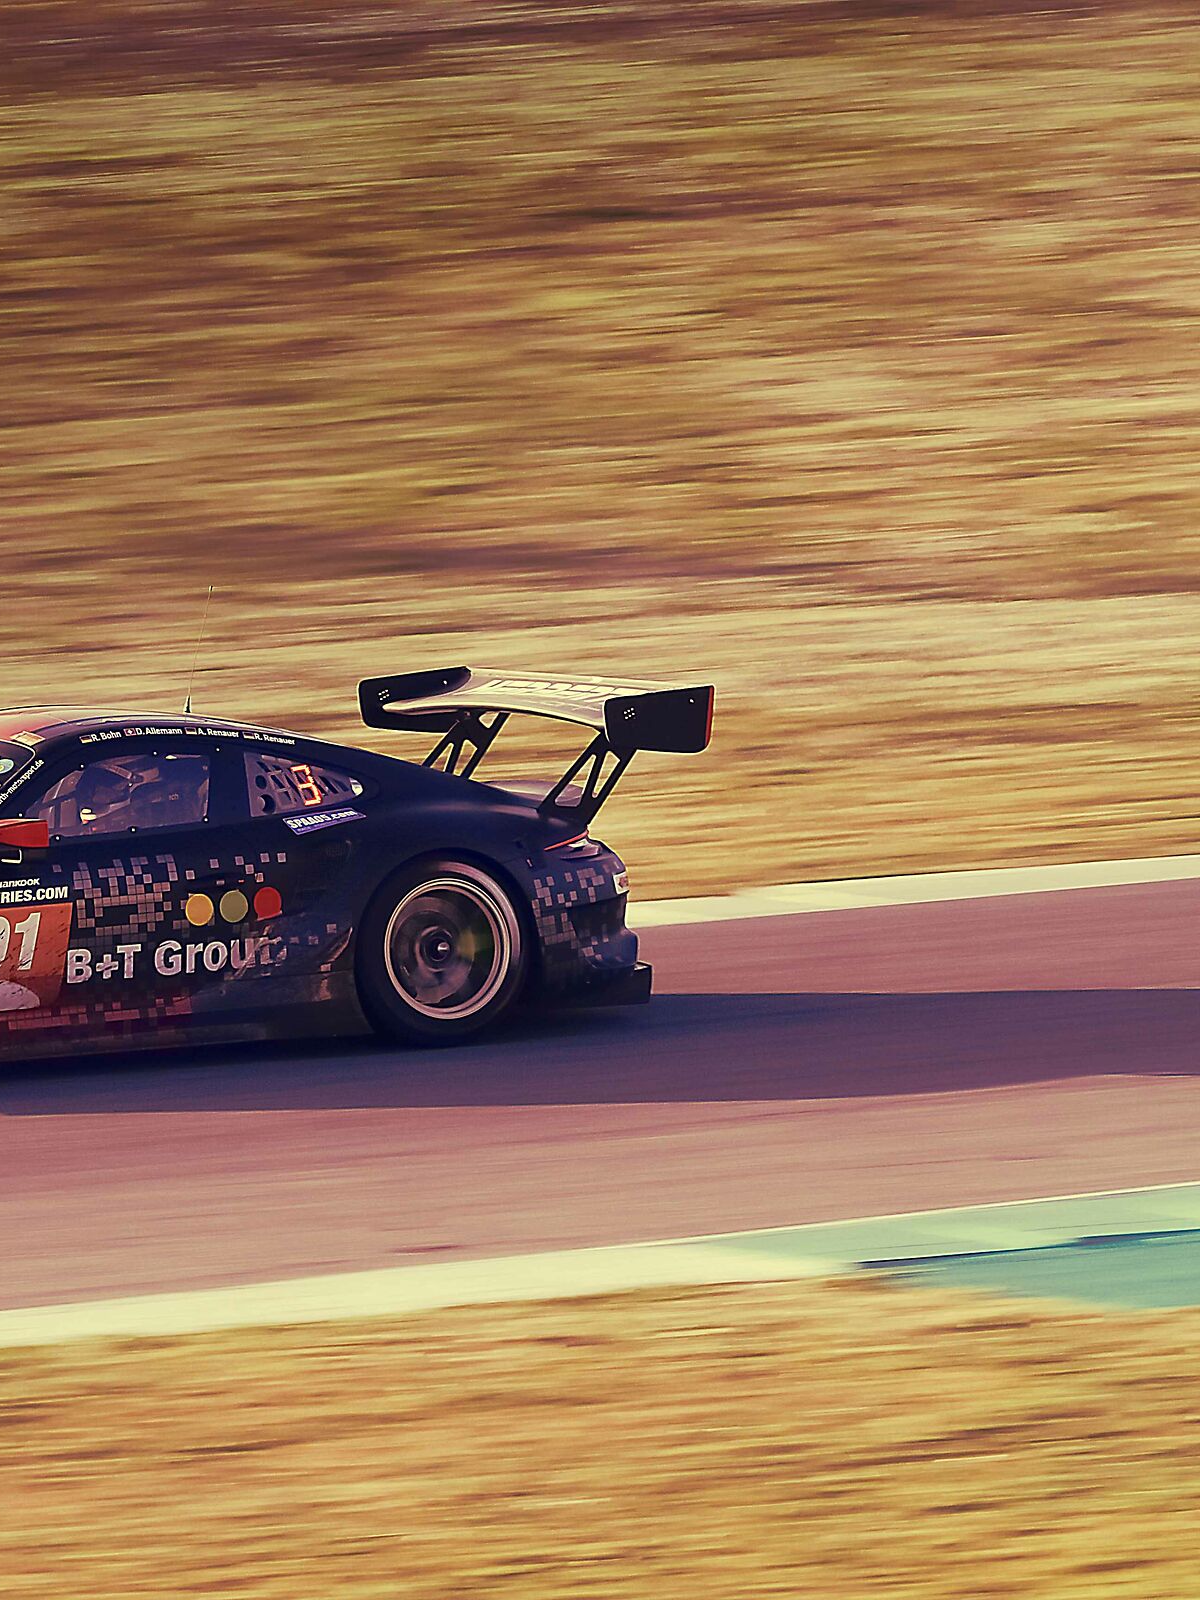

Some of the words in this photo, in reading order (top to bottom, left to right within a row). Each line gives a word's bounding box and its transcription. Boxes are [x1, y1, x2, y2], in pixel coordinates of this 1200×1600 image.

[91, 733, 100, 742] R.
[100, 730, 122, 741] Bohn
[135, 727, 146, 736] D.
[145, 726, 183, 735] Allemann
[197, 727, 207, 736] A.
[206, 728, 240, 738] Renauer
[253, 732, 263, 741] R.
[262, 734, 296, 746] Renauer
[66, 943, 142, 985] B+T
